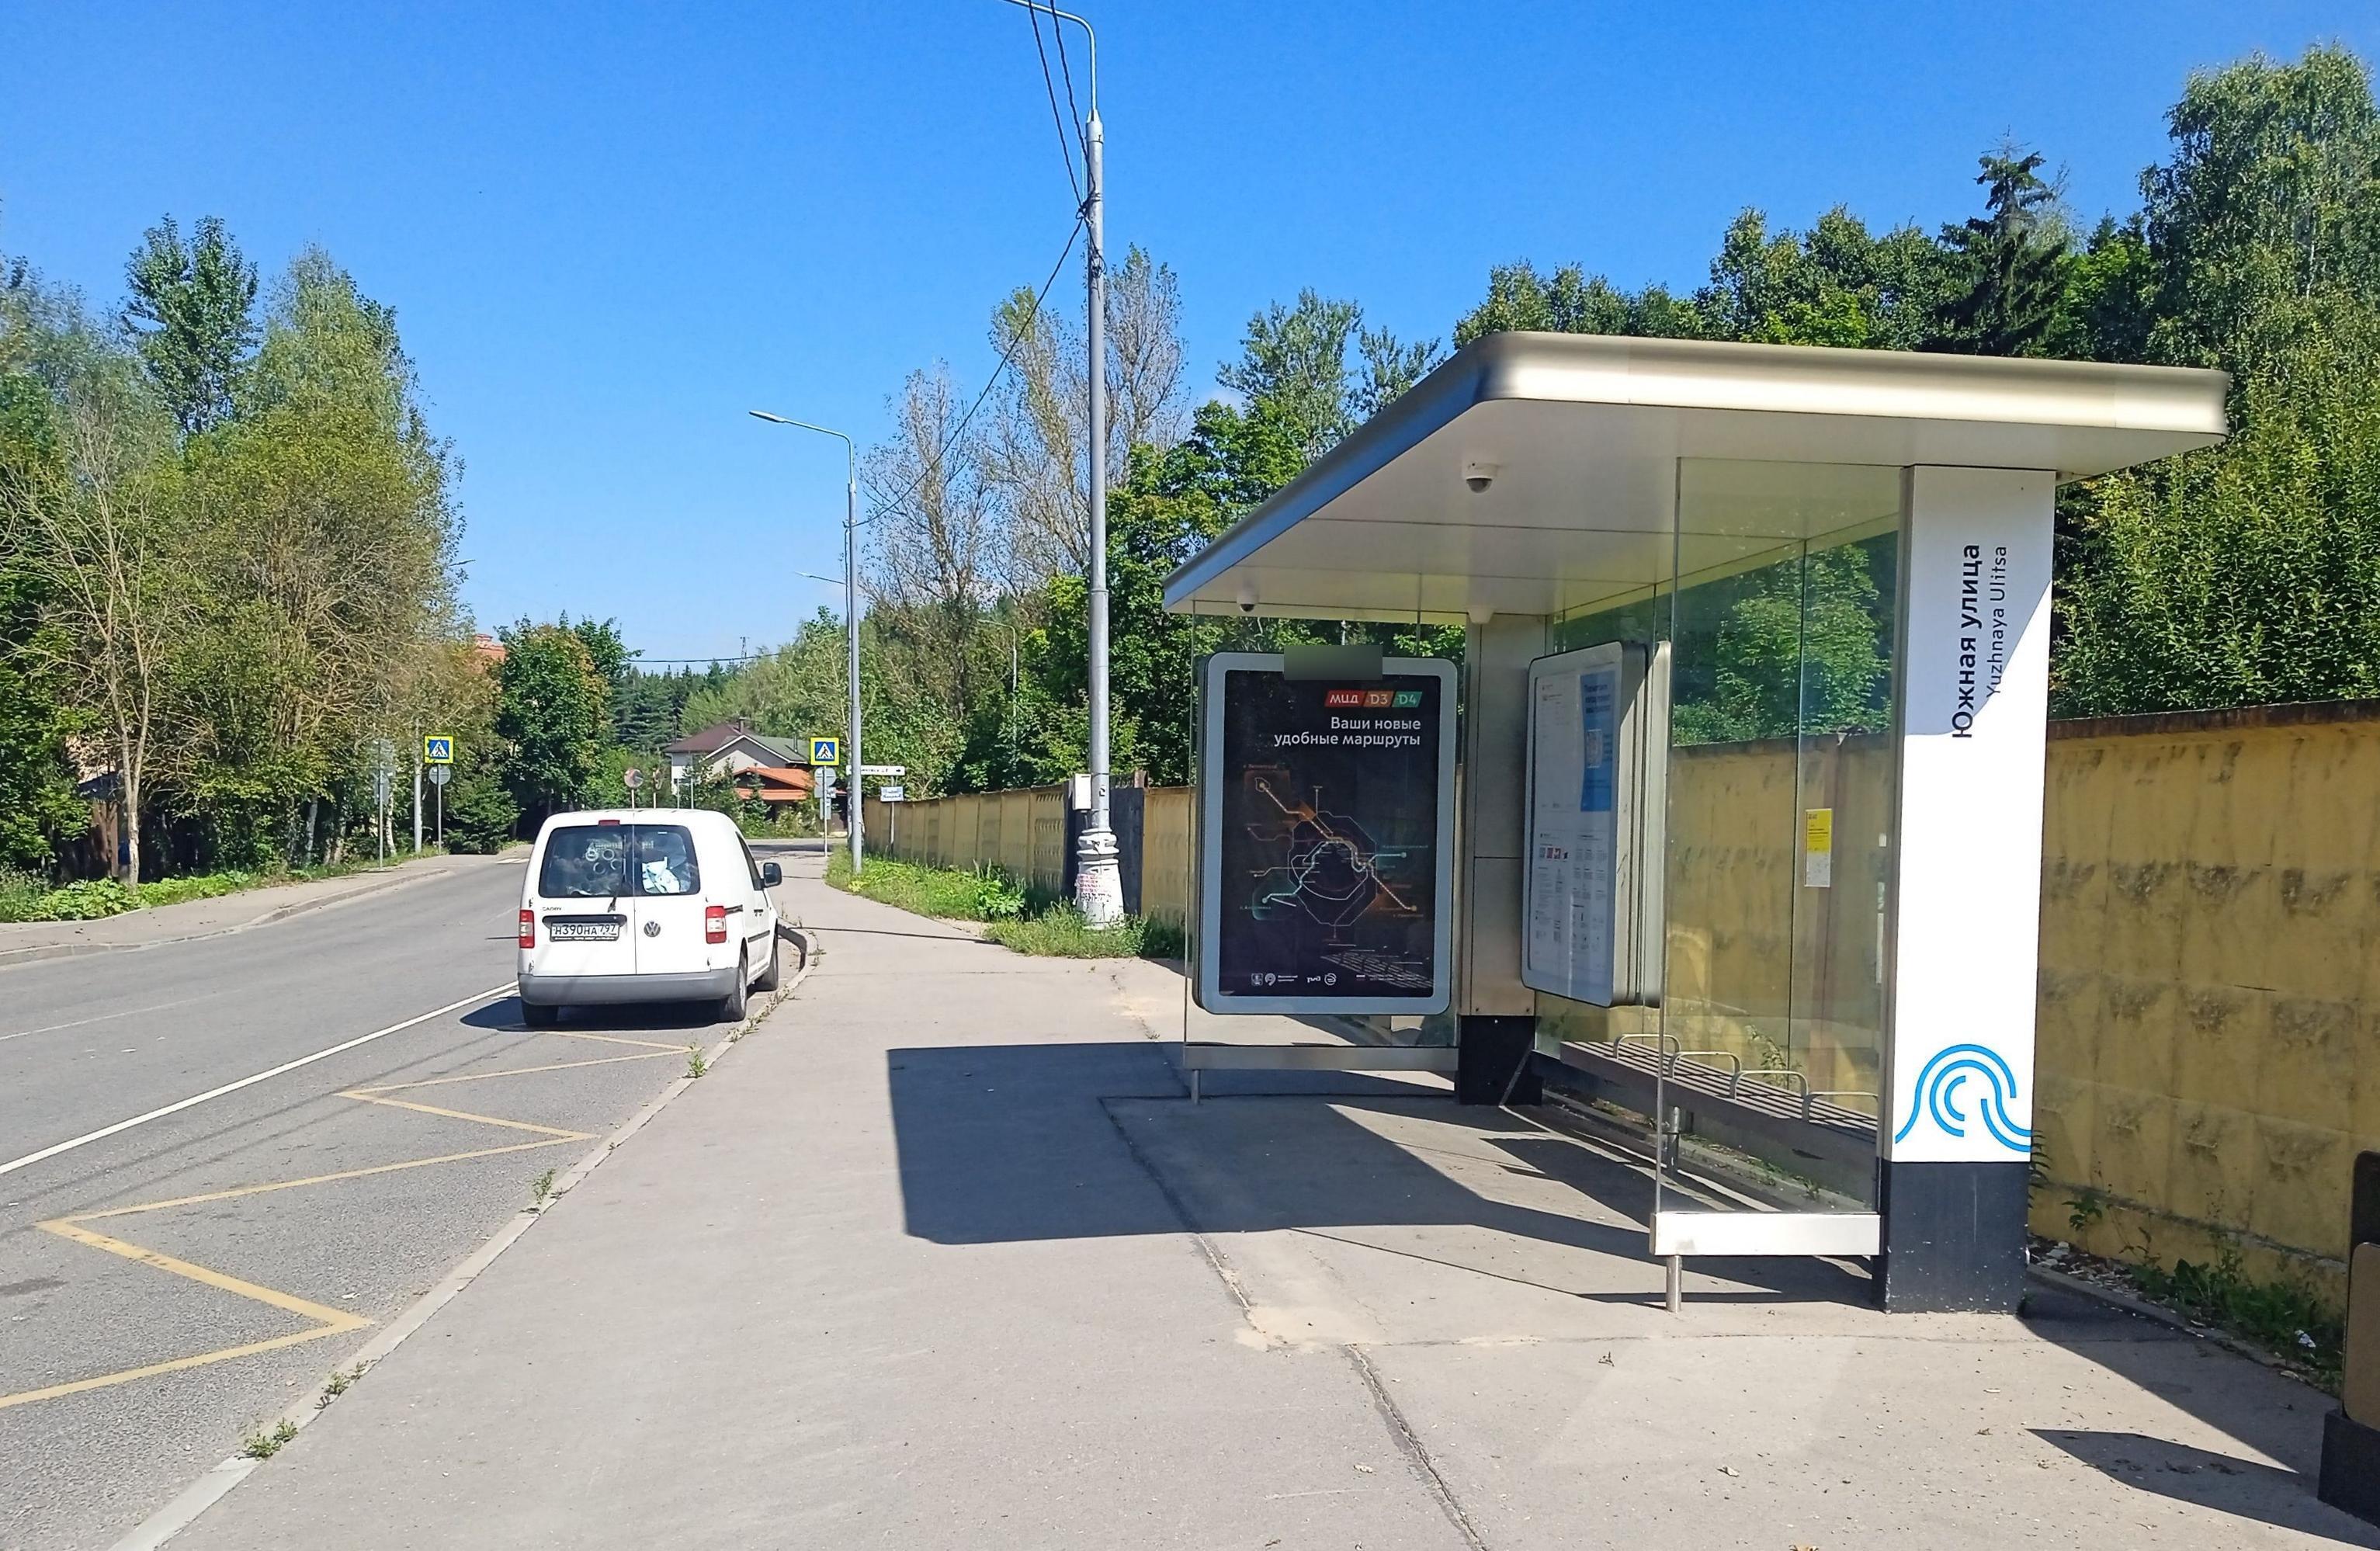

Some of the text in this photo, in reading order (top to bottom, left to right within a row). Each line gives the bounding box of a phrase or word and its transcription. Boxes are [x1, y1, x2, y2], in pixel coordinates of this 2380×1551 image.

[1986, 546, 2007, 698] Yuzhnaya Ulitsa
[1952, 544, 1983, 738] Южная улица
[1329, 694, 1417, 704] МЦД D3 D4
[1331, 717, 1421, 730] Ваши новые
[1274, 731, 1421, 748] удобные маршруты
